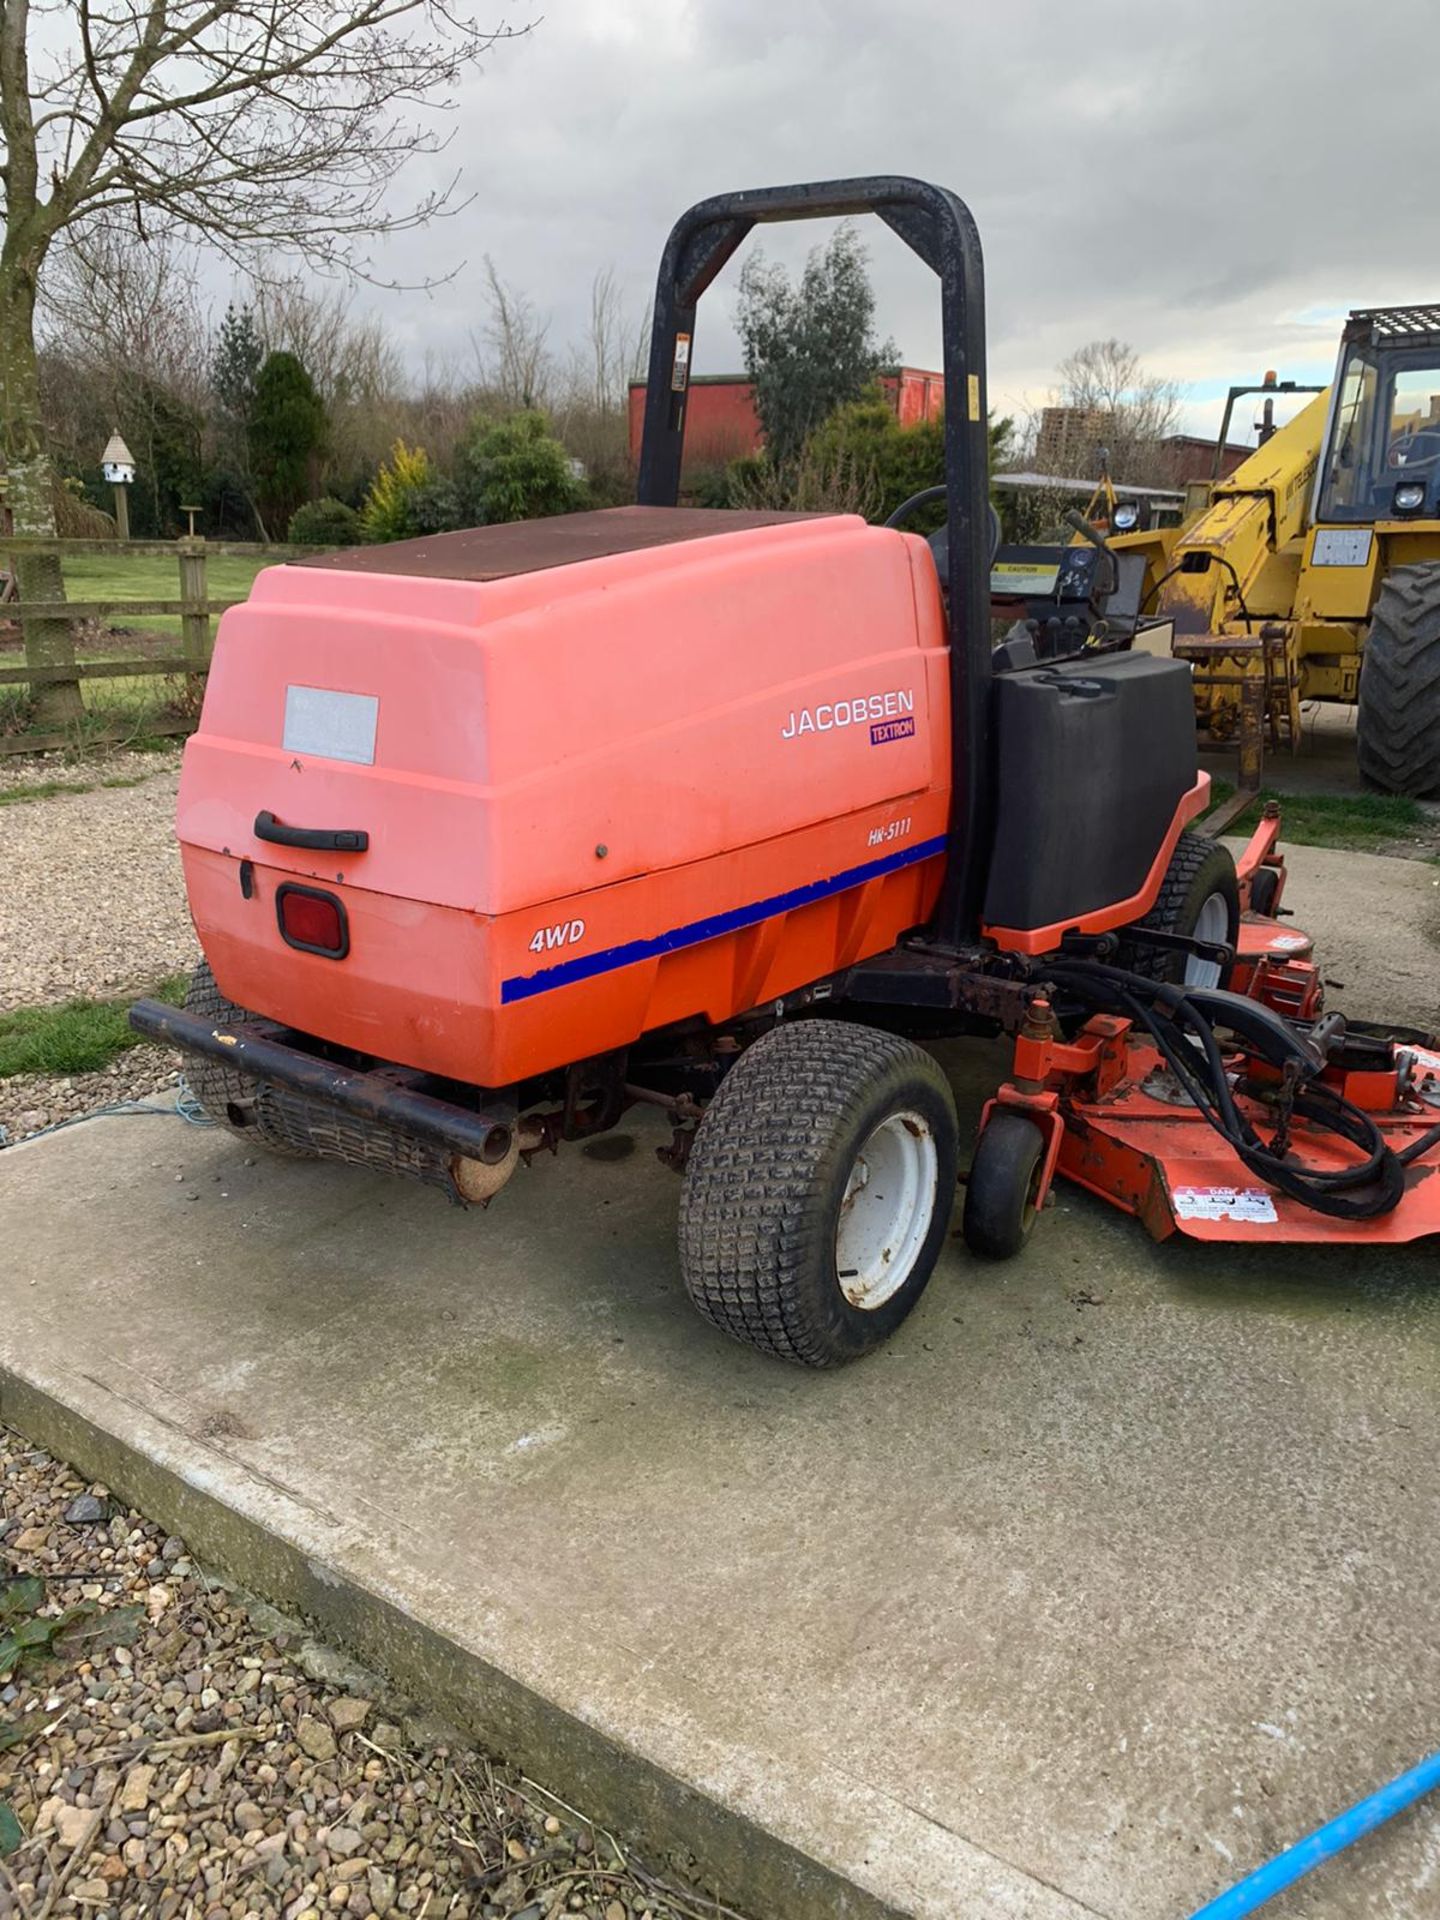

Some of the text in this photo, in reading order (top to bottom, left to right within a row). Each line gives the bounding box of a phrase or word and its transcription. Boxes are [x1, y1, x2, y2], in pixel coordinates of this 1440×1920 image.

[1007, 566, 1038, 574] CAUTION
[781, 689, 914, 738] JACOBSEN
[871, 720, 913, 743] TEXTRON
[529, 920, 585, 952] 4WD
